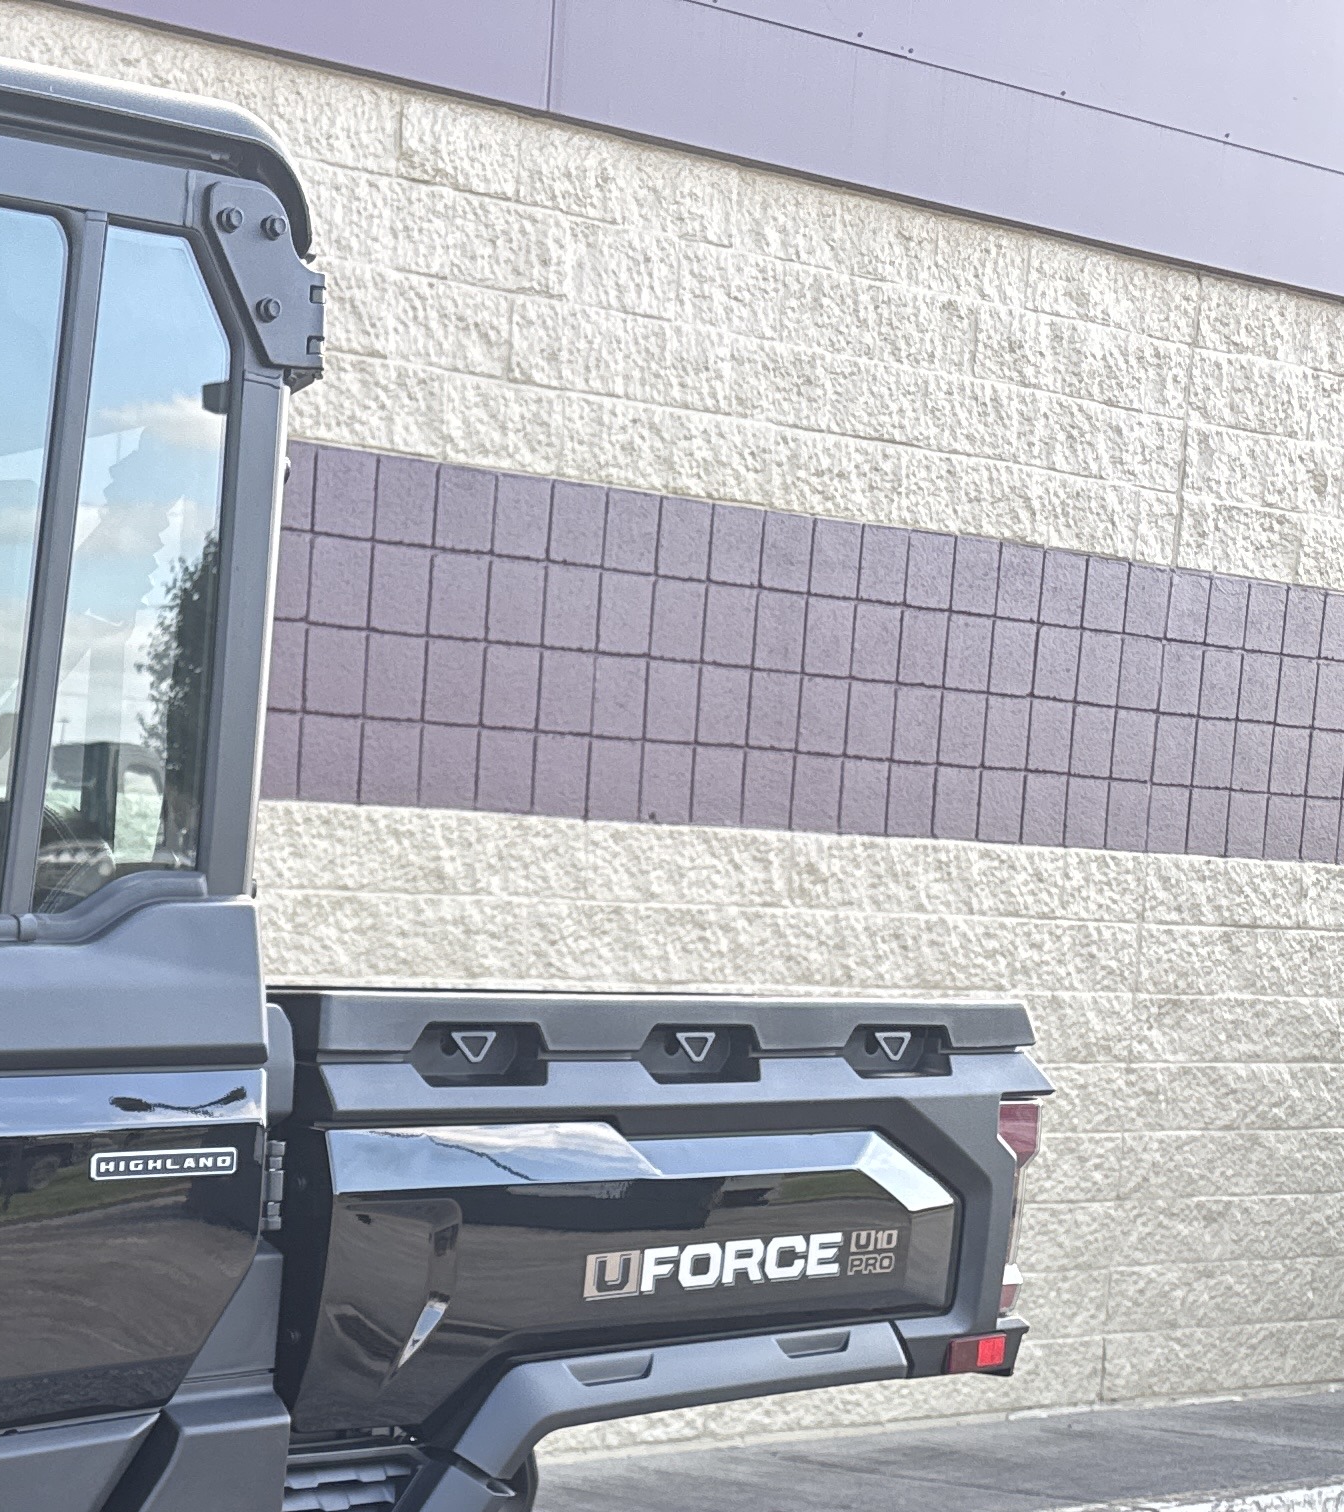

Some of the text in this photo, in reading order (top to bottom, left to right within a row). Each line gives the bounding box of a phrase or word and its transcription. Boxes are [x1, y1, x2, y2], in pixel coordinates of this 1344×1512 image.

[99, 1155, 232, 1173] HIGHLAND
[583, 1229, 899, 1301] UFORCE U10
[846, 1252, 895, 1276] PRO
